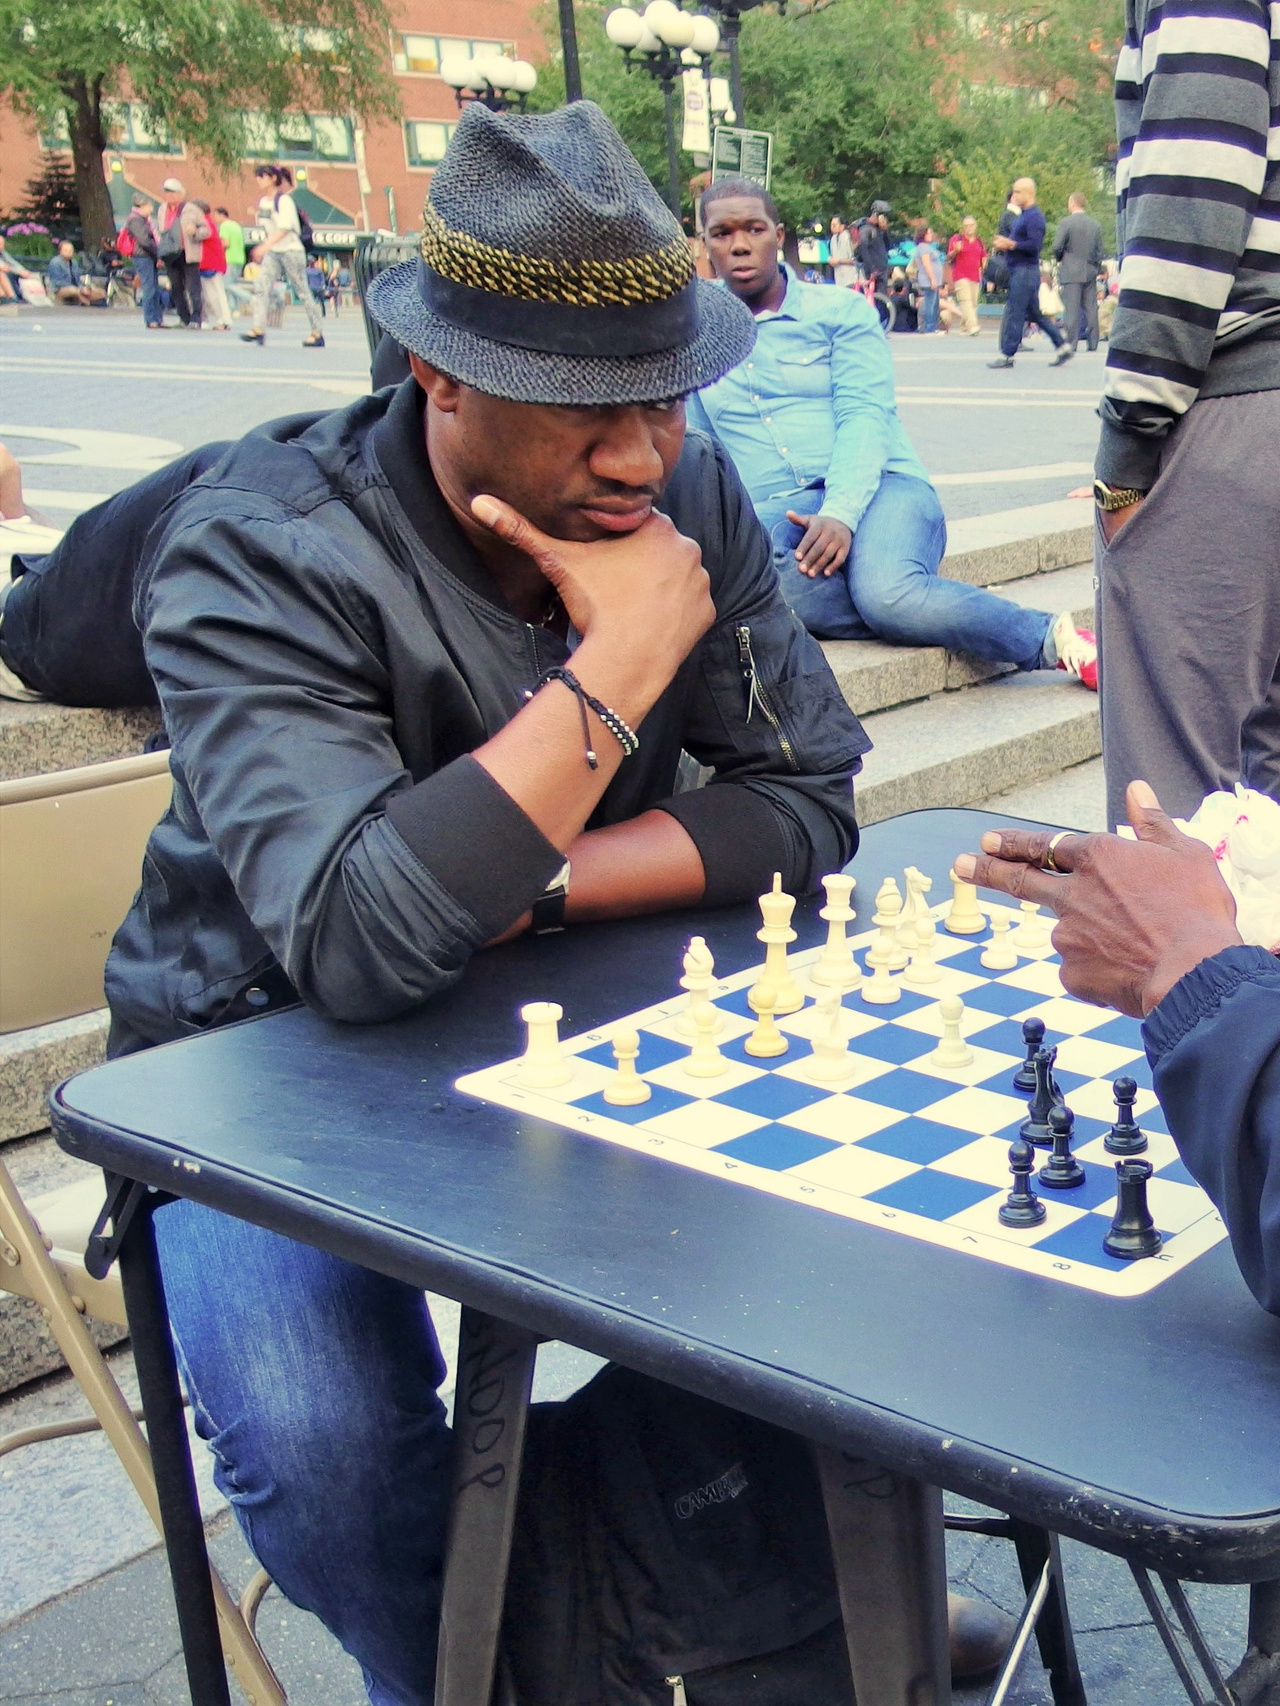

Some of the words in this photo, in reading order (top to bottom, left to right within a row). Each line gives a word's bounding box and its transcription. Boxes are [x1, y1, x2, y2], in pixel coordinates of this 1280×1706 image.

[577, 1115, 596, 1123] 2
[647, 1137, 666, 1146] 3
[723, 1161, 739, 1170] 4
